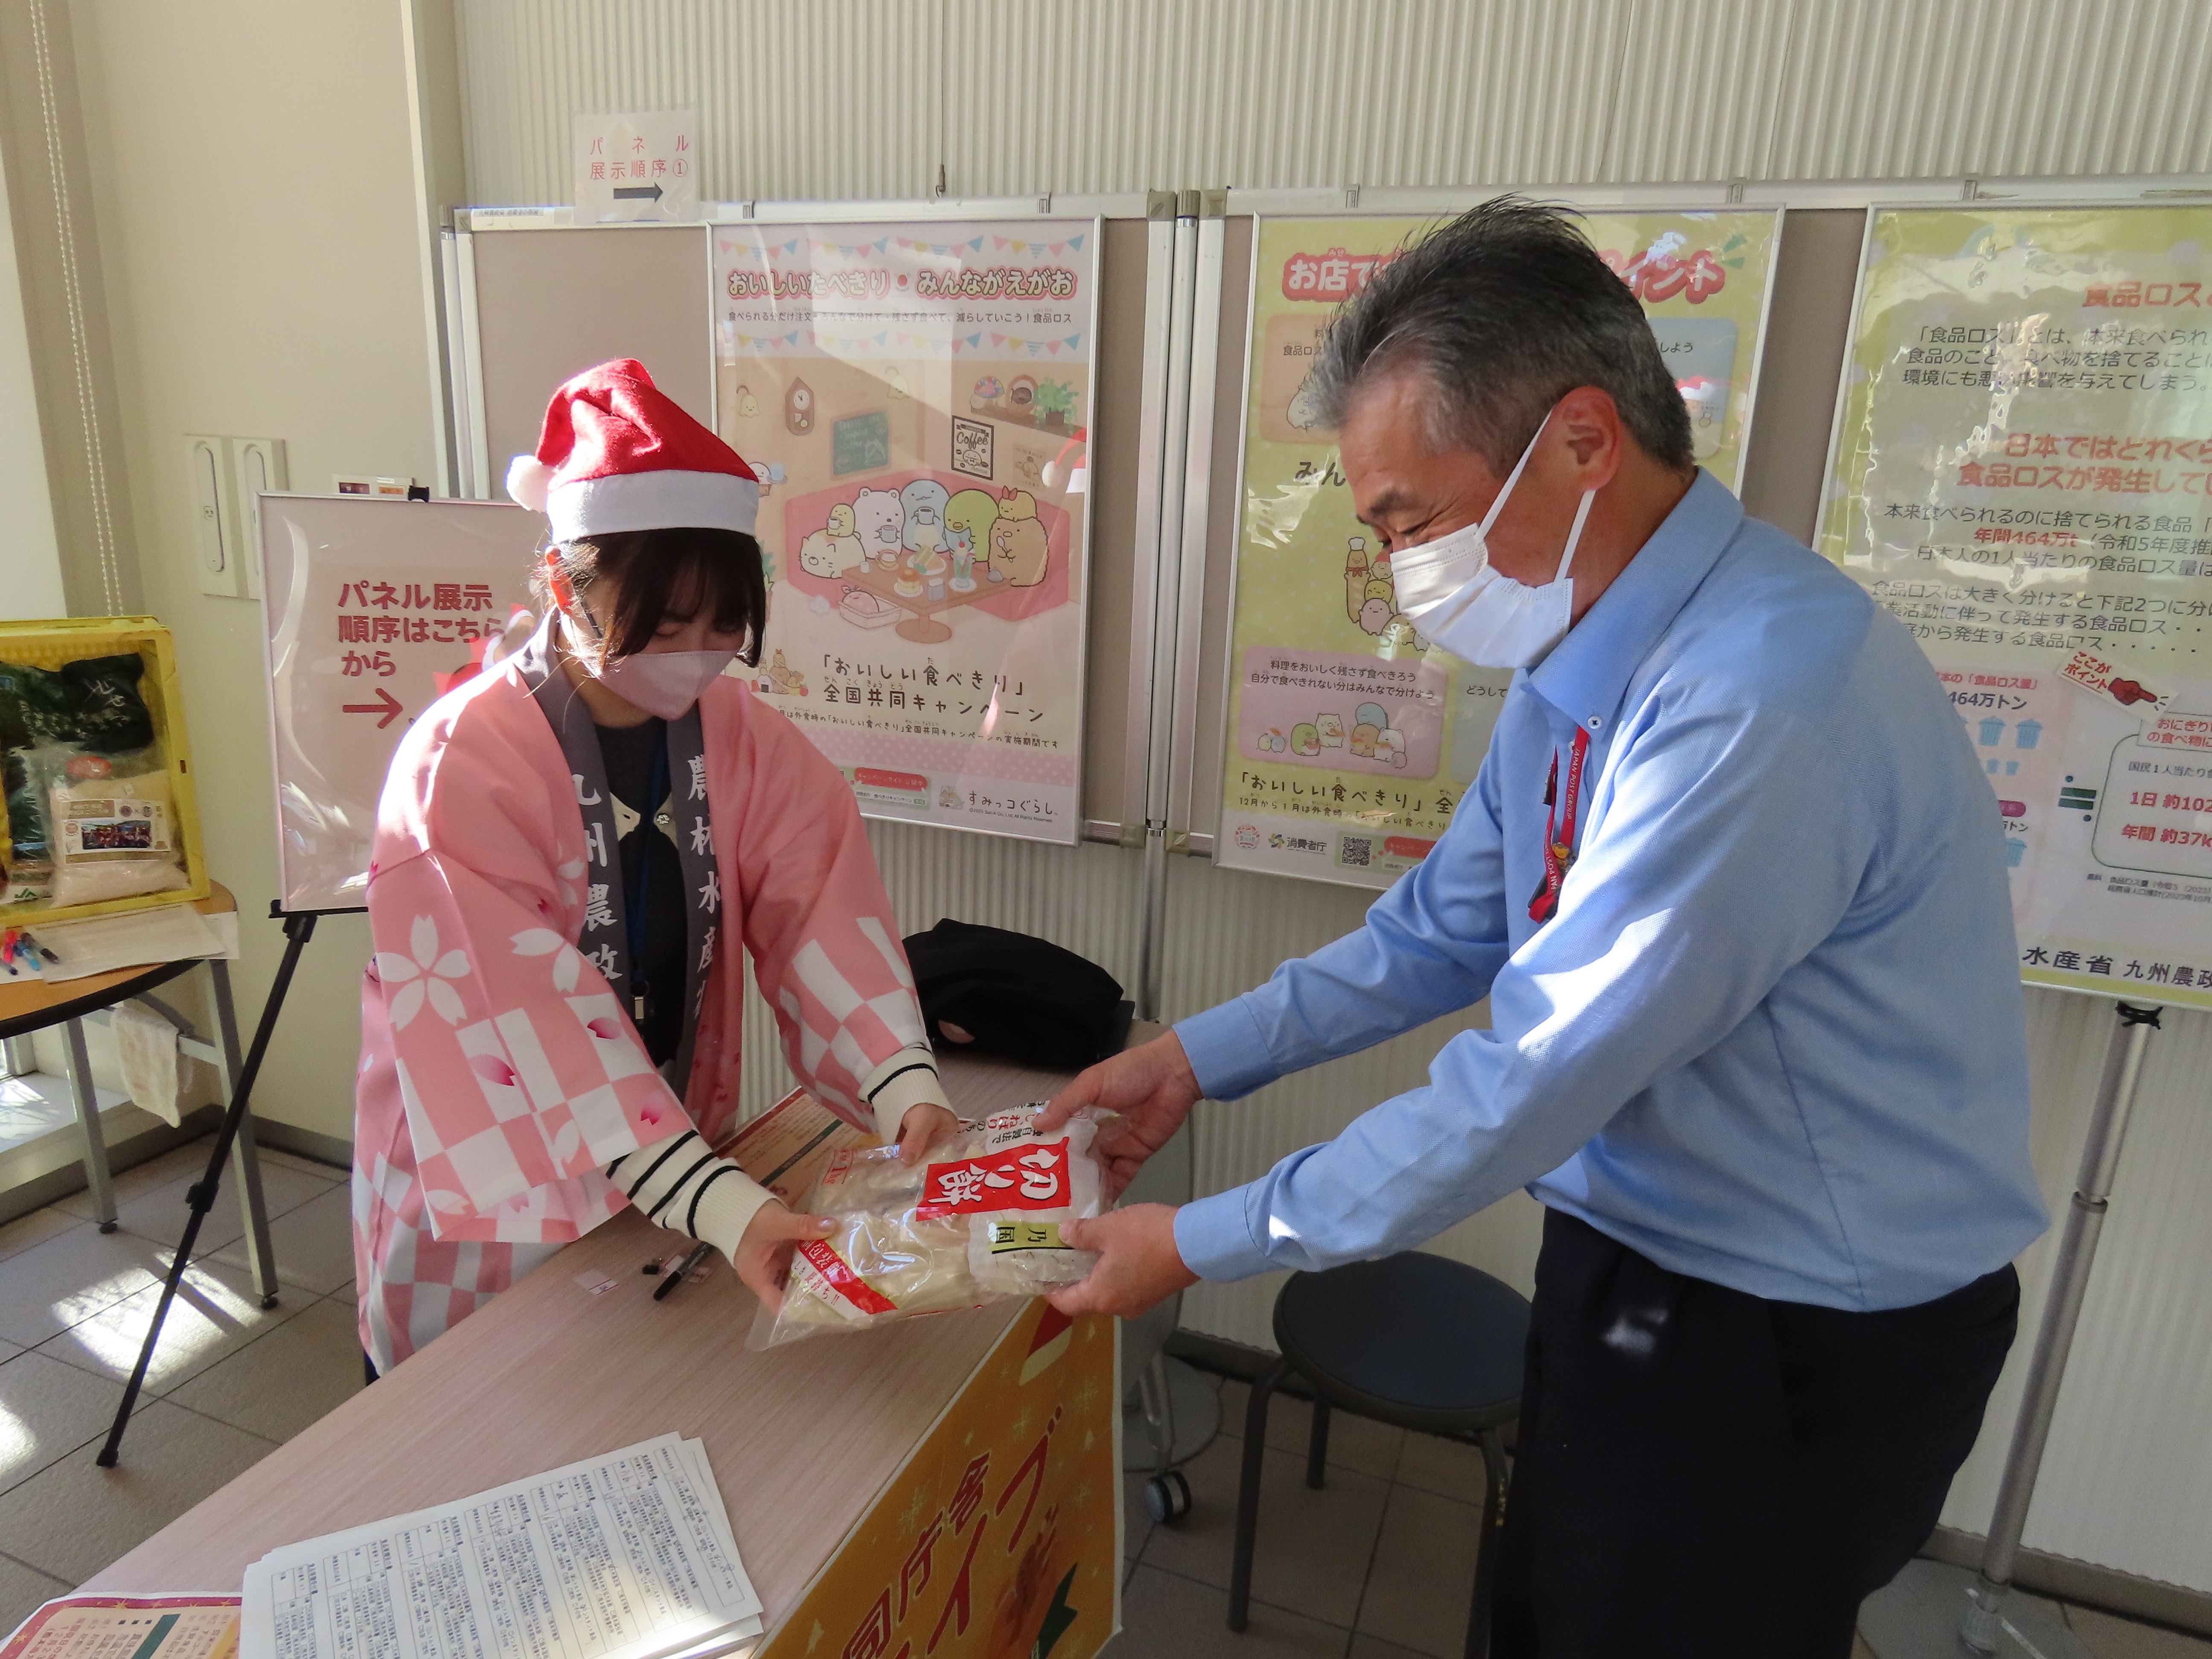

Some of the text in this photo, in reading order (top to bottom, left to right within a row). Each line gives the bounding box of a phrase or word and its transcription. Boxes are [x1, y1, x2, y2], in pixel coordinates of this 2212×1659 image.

[590, 134, 689, 155] パネル
[590, 158, 688, 180] 展示順序①
[728, 269, 1073, 298] おいしいたべきり みんながえがお
[1289, 256, 1718, 292] お店で イント
[2082, 281, 2212, 308] 食品ロス
[1659, 342, 1694, 353] しよう
[957, 431, 989, 450] Coffee
[337, 580, 492, 611] パネル展示
[338, 615, 505, 643] 順序はこちら
[341, 650, 397, 677] から
[824, 654, 1023, 696] 「おいしい食べきり」
[2073, 651, 2112, 674] ここが
[2064, 663, 2108, 690] ポイント
[2157, 718, 2212, 733] おにぎり
[1572, 747, 1580, 773] JAPAN
[1568, 773, 1577, 794] POST
[969, 790, 1053, 815] すみっコぐらし
[2130, 792, 2158, 807] 1日
[1286, 837, 1327, 852] 消費者庁
[2121, 824, 2157, 842] 年間
[2022, 946, 2113, 975] 水産省
[928, 1148, 1060, 1206] 切り餅
[894, 1404, 1063, 1659] イブ
